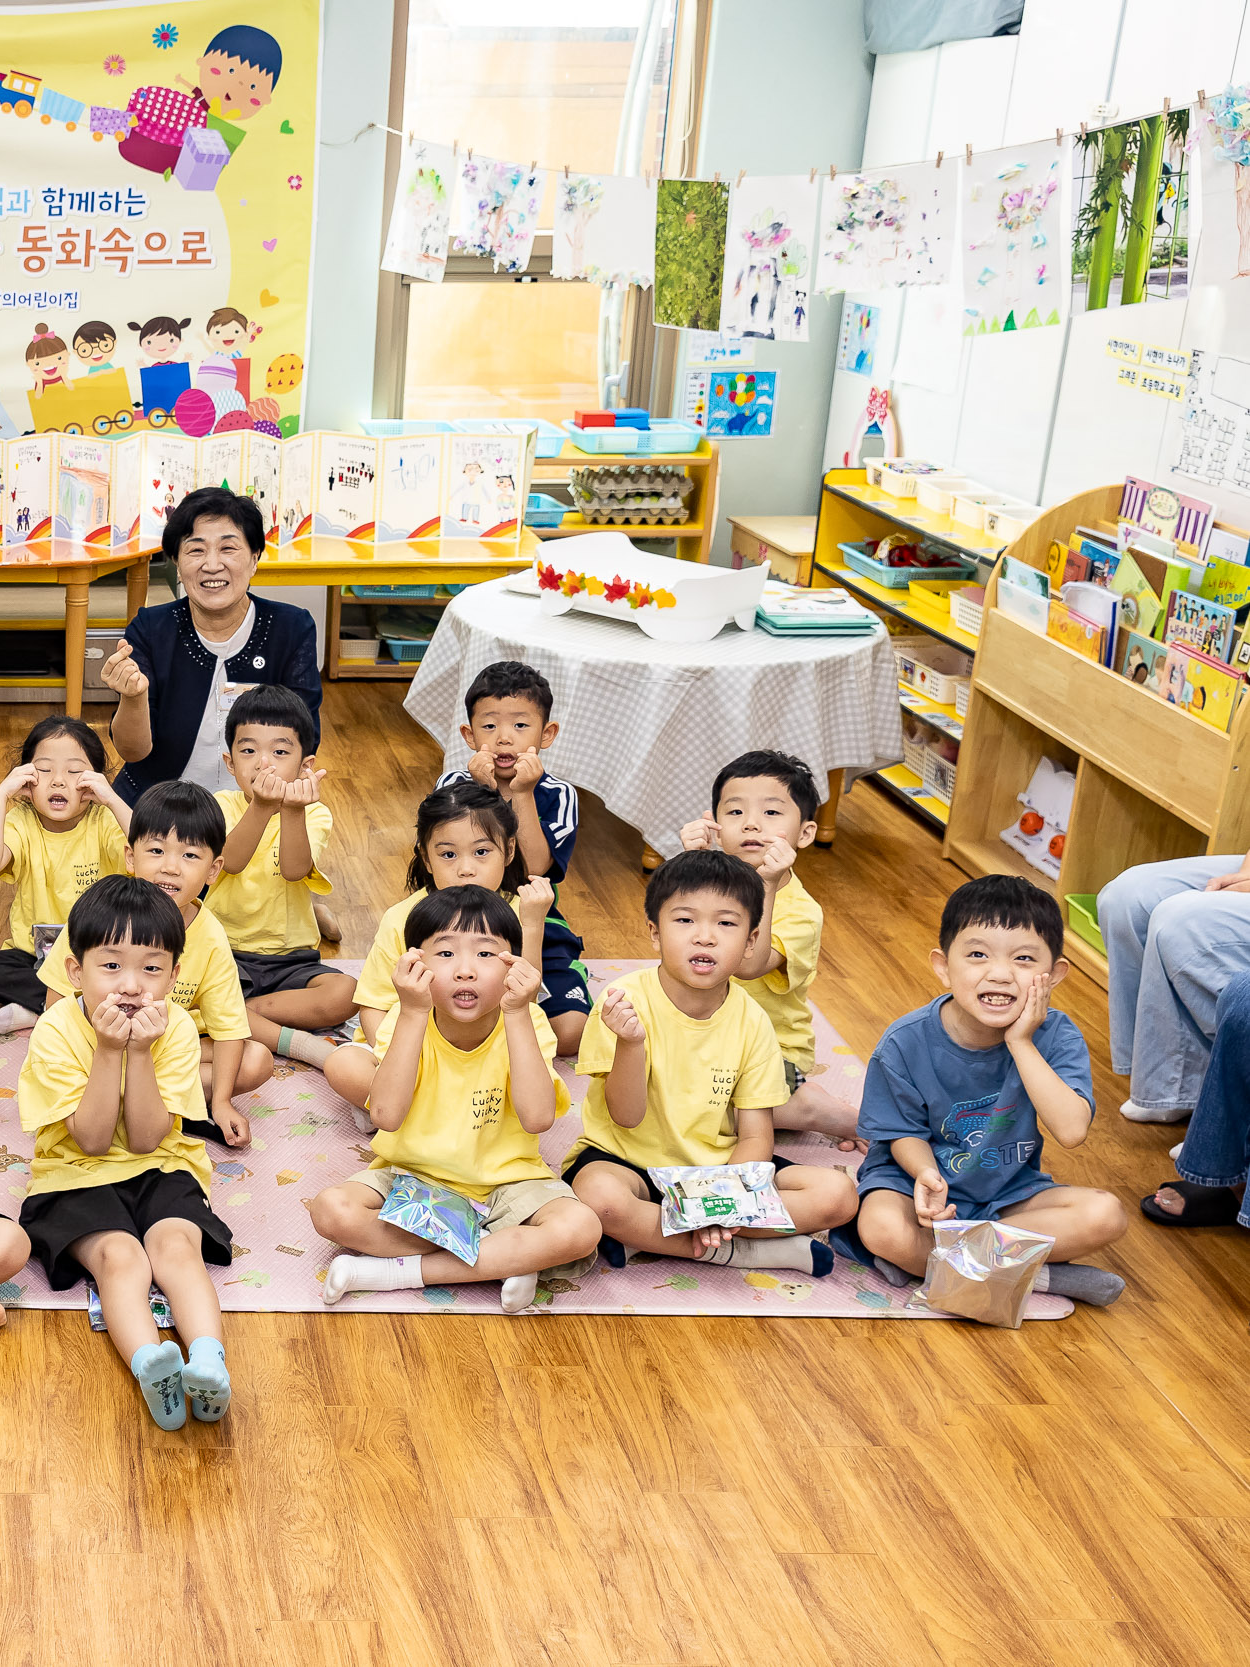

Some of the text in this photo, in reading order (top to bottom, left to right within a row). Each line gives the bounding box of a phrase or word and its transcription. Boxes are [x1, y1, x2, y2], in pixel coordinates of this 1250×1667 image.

[41, 187, 146, 217] 함께하는
[17, 225, 212, 273] 동화속으로
[75, 867, 100, 877] Lucky
[172, 986, 196, 996] Luck
[171, 996, 193, 1004] Vick
[712, 1086, 731, 1096] Vic
[472, 1093, 502, 1106] Lucky
[472, 1105, 500, 1119] Vicky
